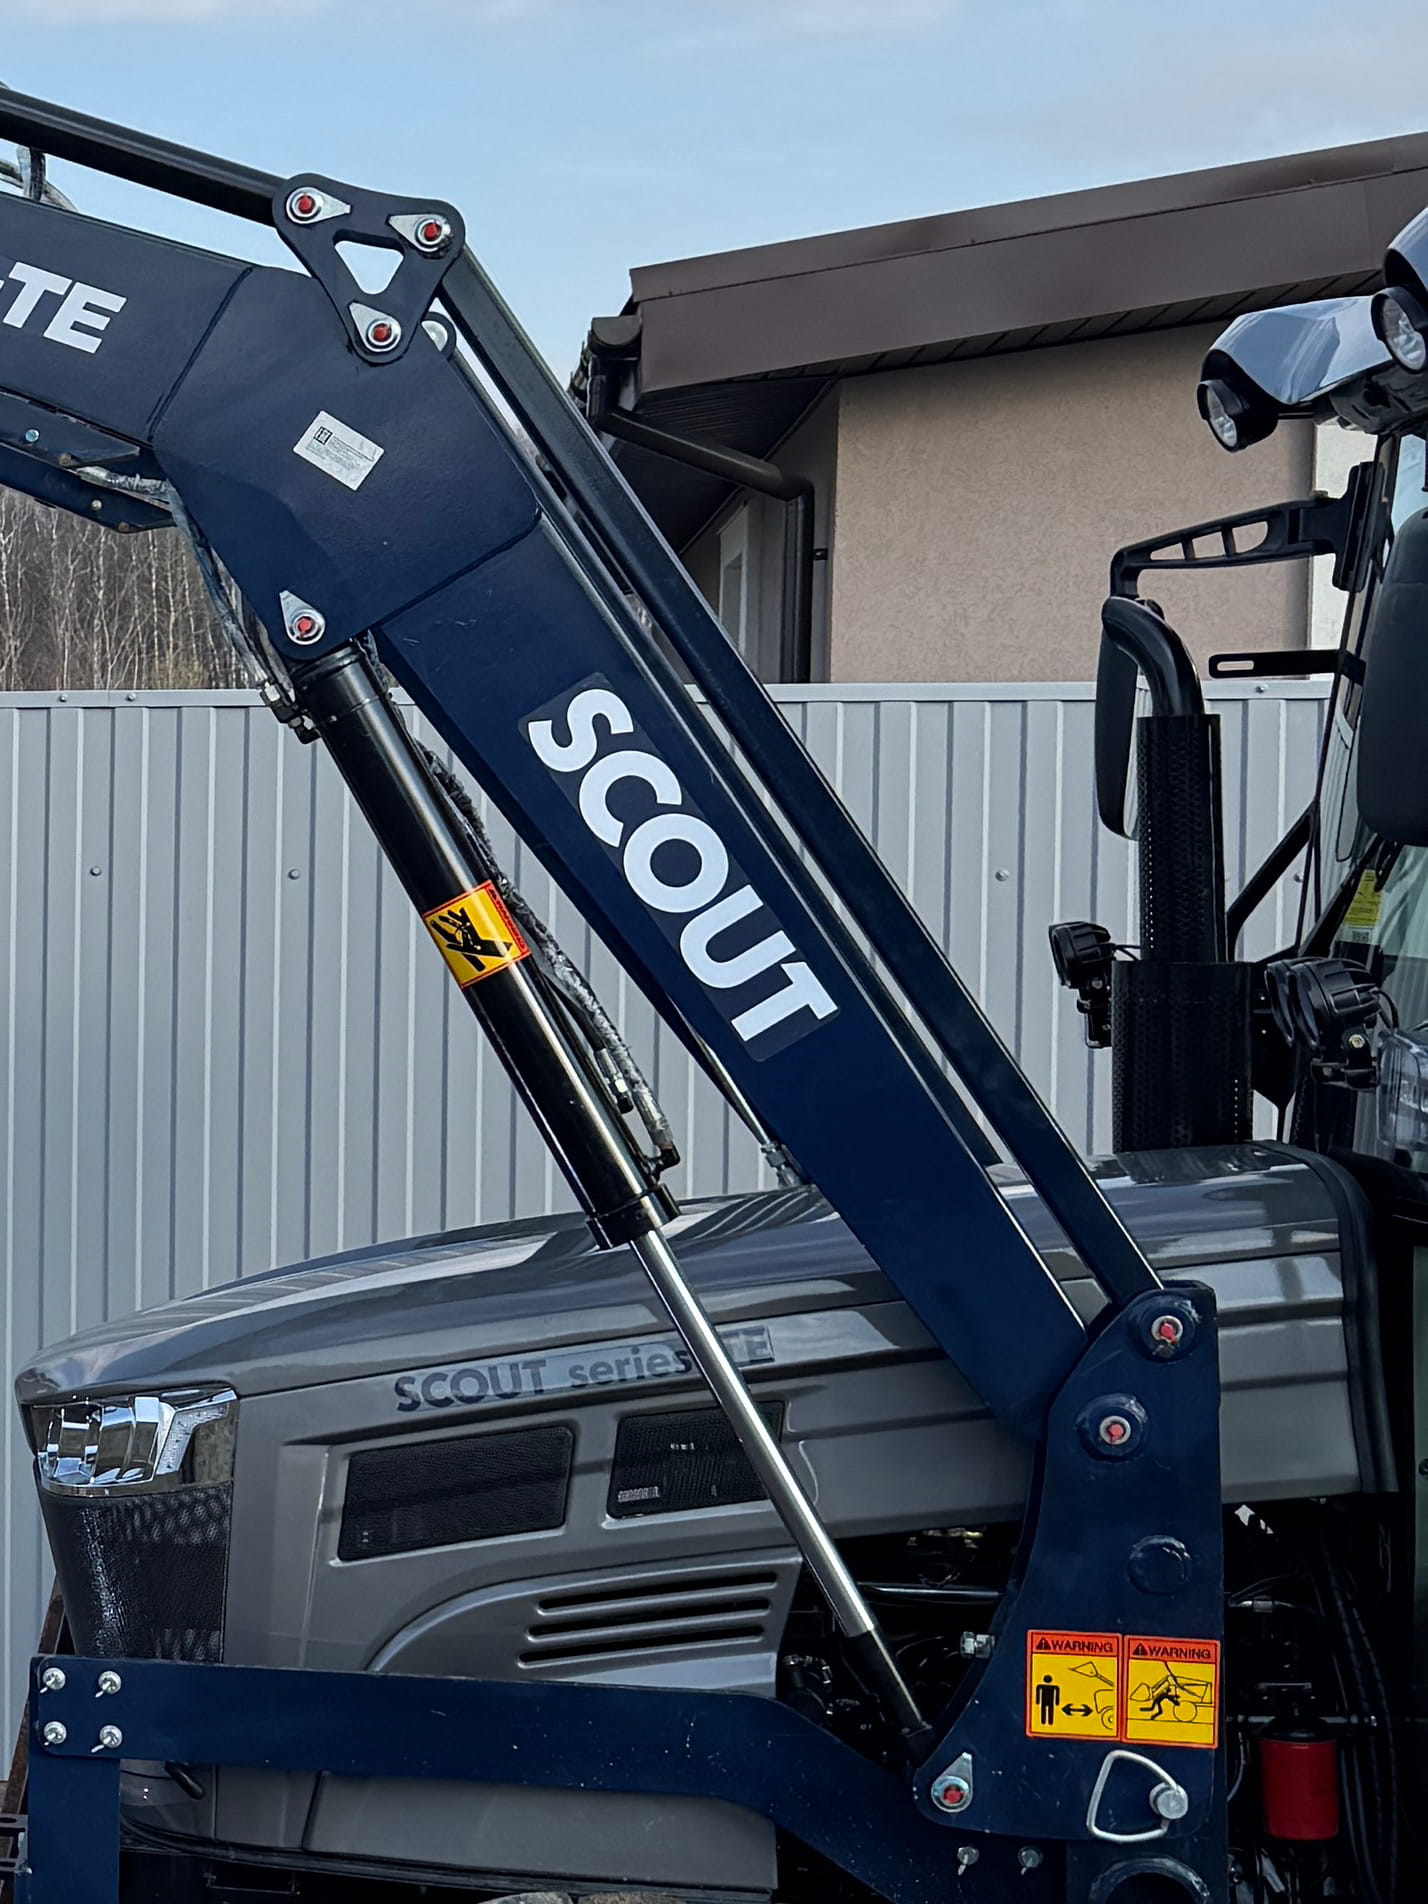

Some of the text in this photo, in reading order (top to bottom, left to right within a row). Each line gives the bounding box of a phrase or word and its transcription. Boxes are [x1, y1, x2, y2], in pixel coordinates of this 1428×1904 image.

[528, 688, 839, 1042] SCOUT
[394, 1360, 547, 1412] SCOUT
[569, 1346, 693, 1389] series
[1051, 1640, 1114, 1653] WARNING
[1148, 1645, 1211, 1659] WARNING
